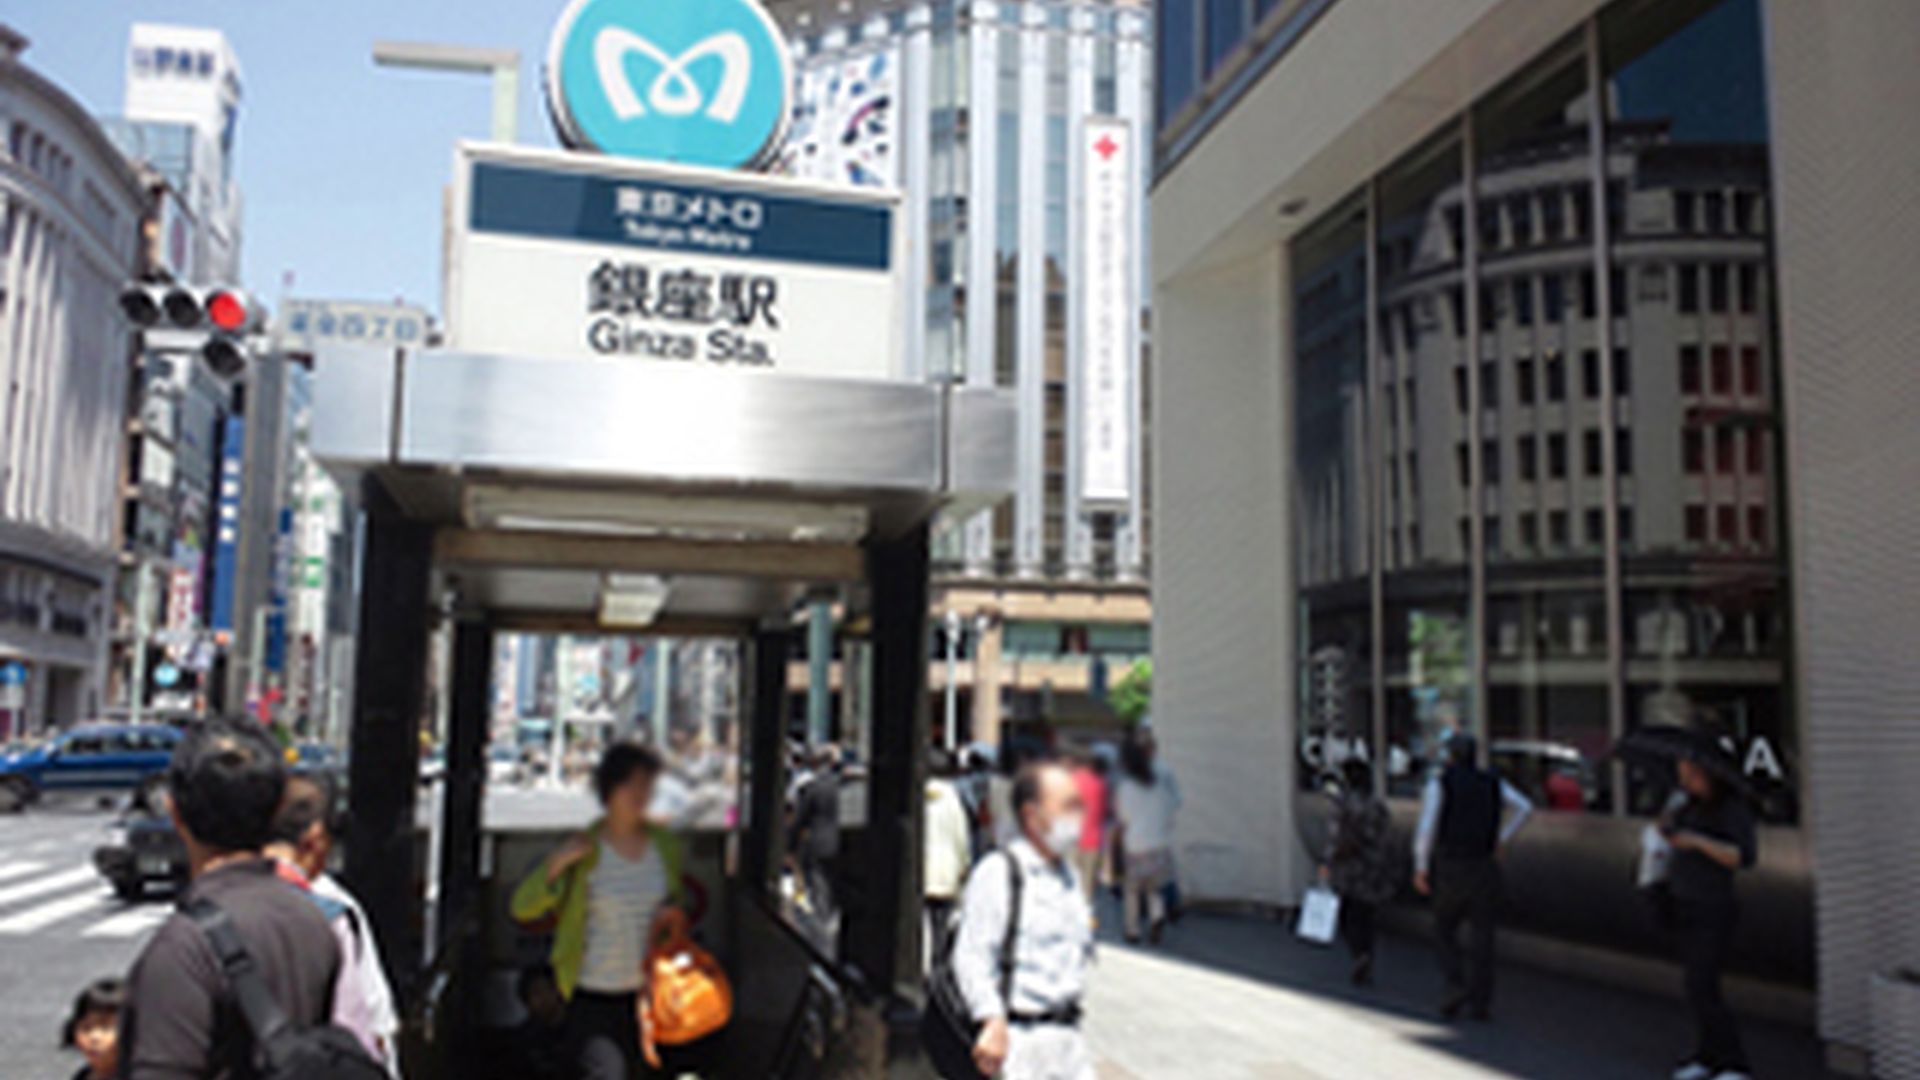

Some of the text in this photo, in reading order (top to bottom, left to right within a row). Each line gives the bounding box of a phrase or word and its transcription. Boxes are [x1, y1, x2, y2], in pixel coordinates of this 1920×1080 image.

[624, 218, 752, 251] Tokyo Metro
[588, 260, 779, 330] 銀座駅
[588, 318, 776, 366] Ginza Sta.
